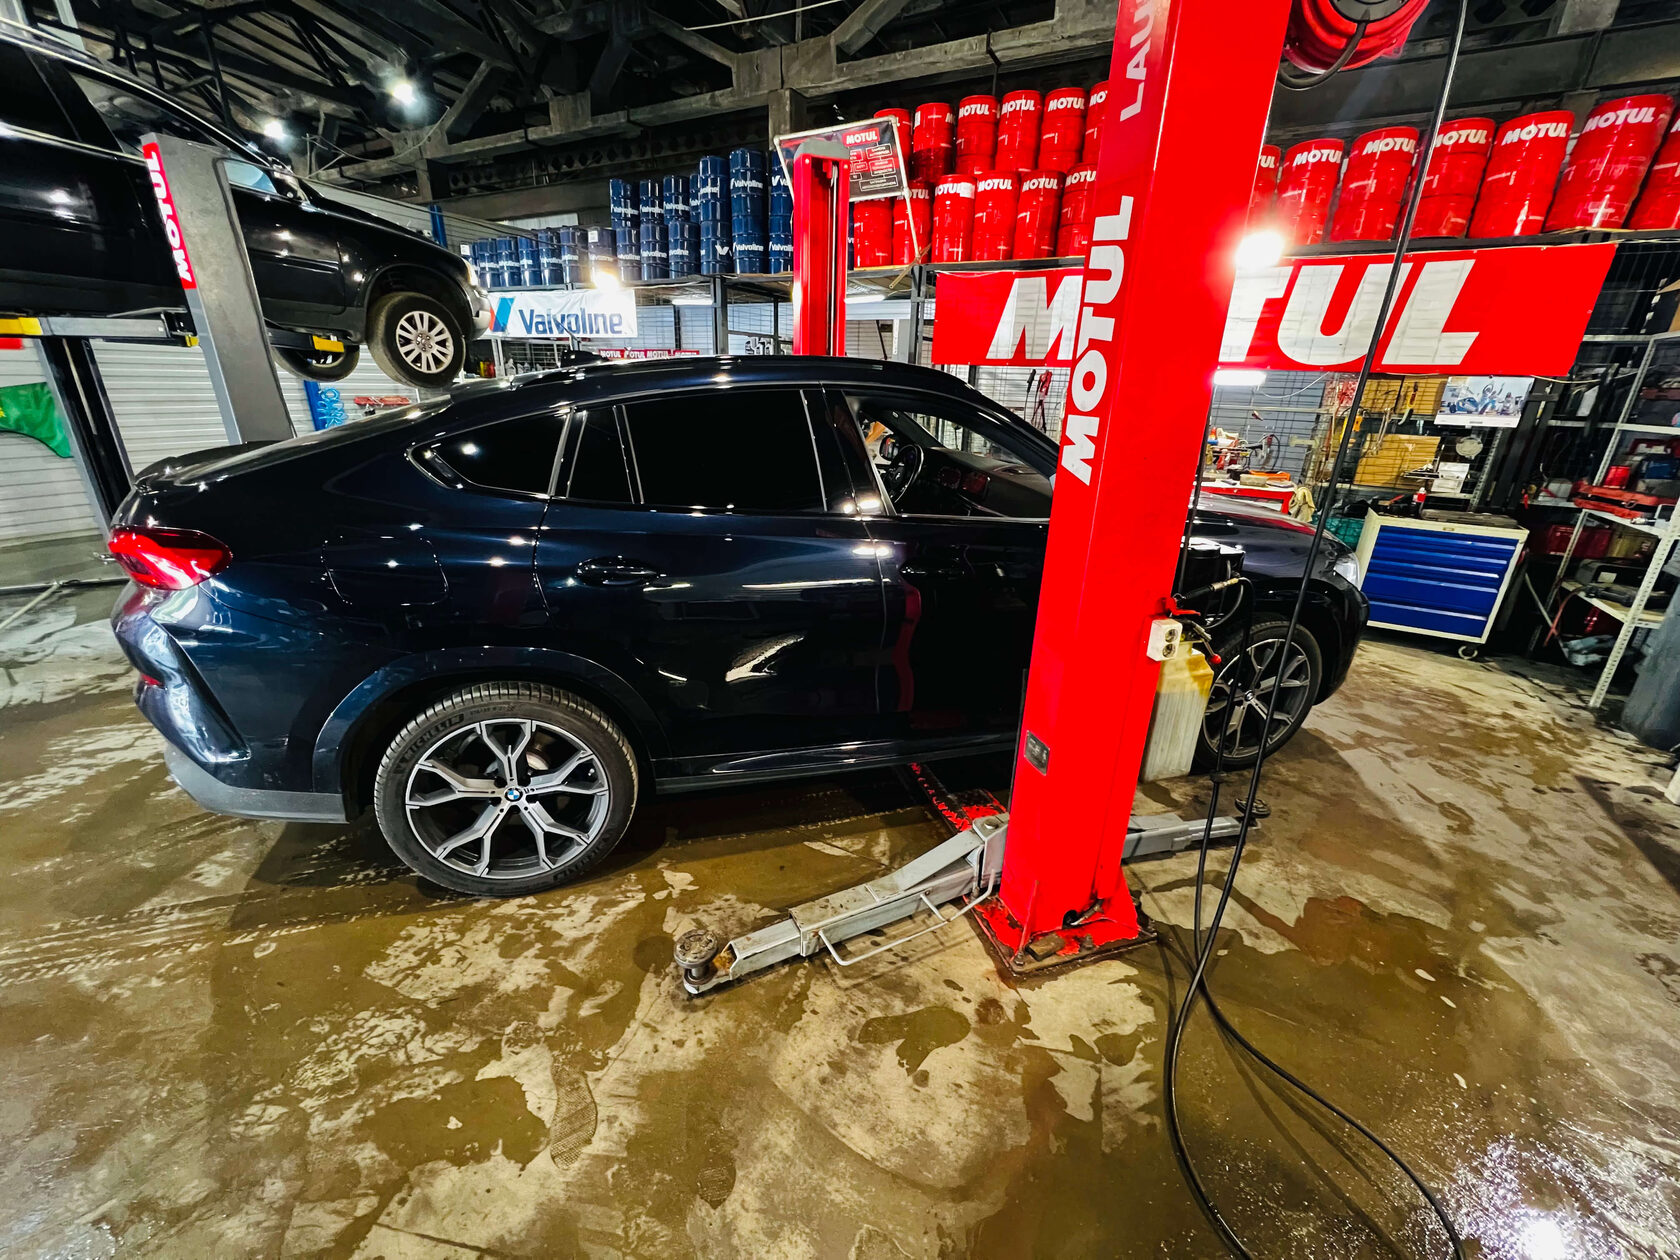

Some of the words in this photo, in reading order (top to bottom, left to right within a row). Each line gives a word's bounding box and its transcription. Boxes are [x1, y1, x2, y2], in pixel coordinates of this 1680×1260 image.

[1120, 0, 1152, 122] LAU
[958, 104, 990, 119] MOTUL
[1001, 99, 1035, 115] MOTUL
[1048, 97, 1085, 113] MOTUL
[1582, 107, 1656, 135] MOTUL
[846, 131, 878, 144] MOTUL
[1501, 122, 1568, 146] MOTUL
[1362, 137, 1416, 156] MOTUL
[977, 179, 1012, 192] MOTUL
[1022, 178, 1058, 192] MOTUL
[1065, 170, 1097, 187] MOTU
[146, 152, 193, 282] MOTUL
[518, 307, 624, 335] Valvoline
[987, 259, 1479, 366] MTUL
[1062, 195, 1134, 486] MOTUL
